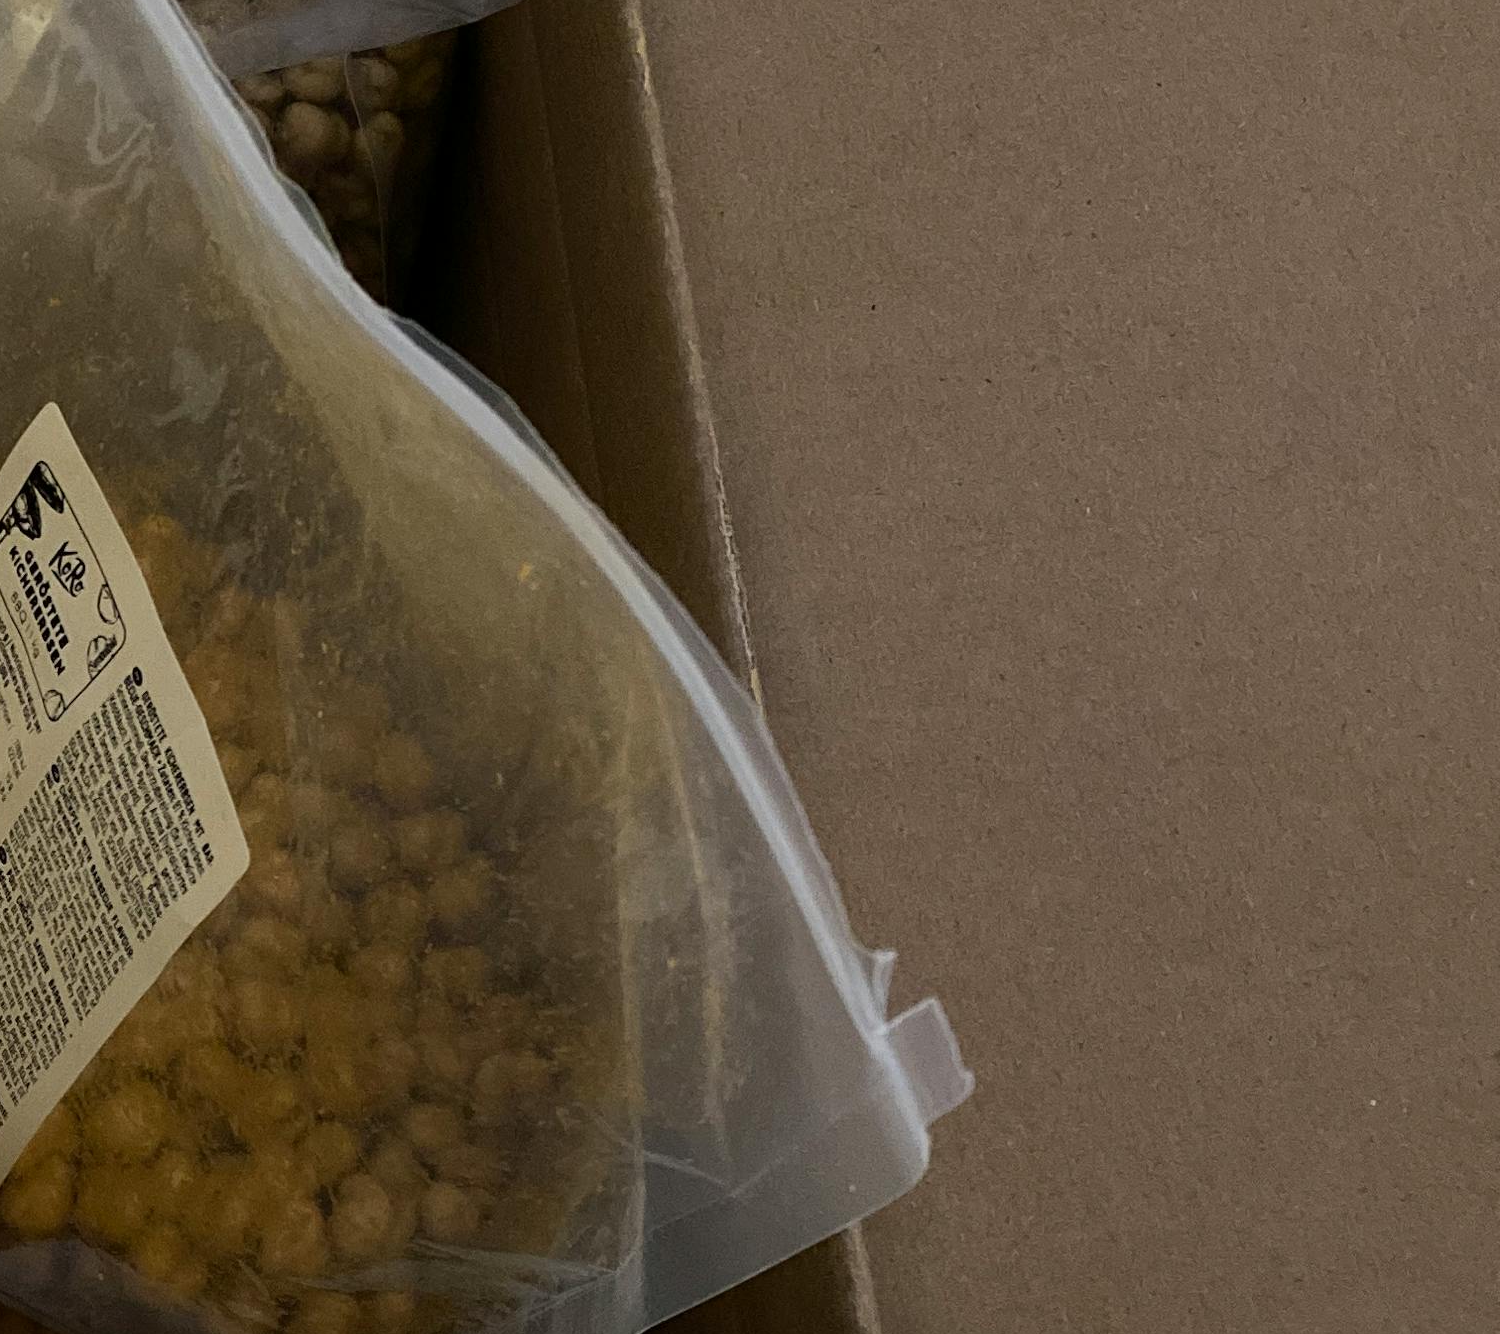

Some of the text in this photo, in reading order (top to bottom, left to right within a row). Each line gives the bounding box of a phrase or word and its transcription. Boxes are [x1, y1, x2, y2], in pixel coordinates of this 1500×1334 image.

[9, 545, 65, 675] KICHERERBSEN
[24, 550, 69, 649] GERÖSTETE
[48, 541, 86, 597] KoRo
